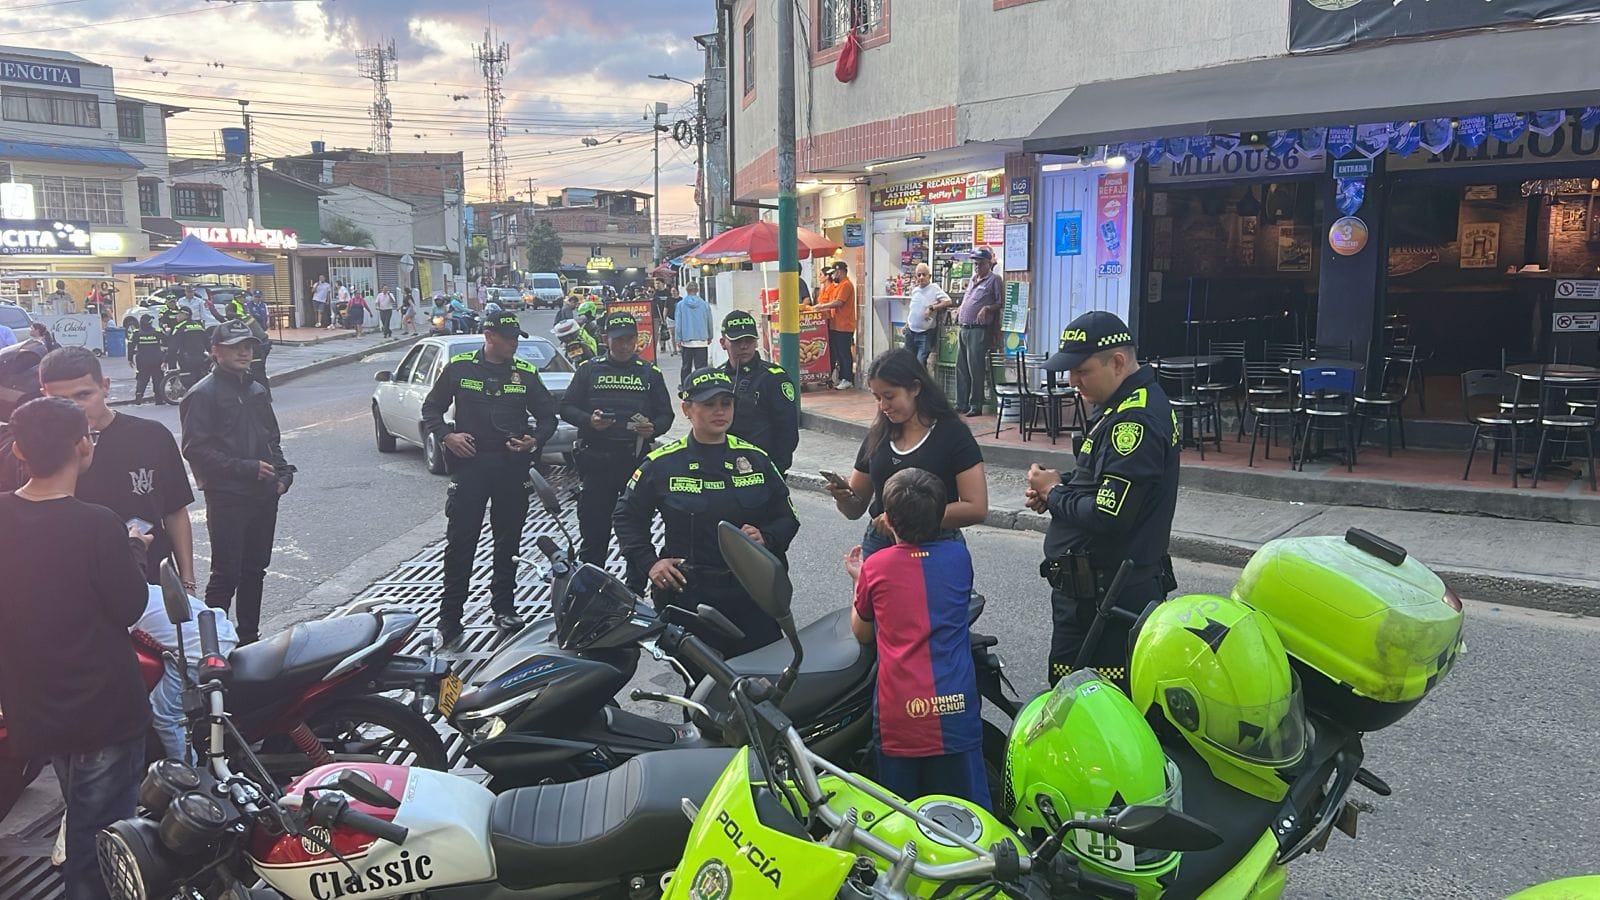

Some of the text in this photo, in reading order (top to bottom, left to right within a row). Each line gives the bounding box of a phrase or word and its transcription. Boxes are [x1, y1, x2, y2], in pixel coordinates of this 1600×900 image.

[1170, 149, 1299, 177] MILOU86
[1338, 164, 1368, 174] ENTRADA
[926, 176, 966, 189] RECARGAS
[887, 190, 952, 200] ASTROS BetPlay
[1100, 264, 1122, 274] 2.500
[598, 374, 642, 385] POLICÍA
[931, 693, 965, 705] UNHCR
[933, 701, 966, 713] ACNUR
[716, 810, 781, 889] POLICÍA
[309, 850, 433, 900] Classic
